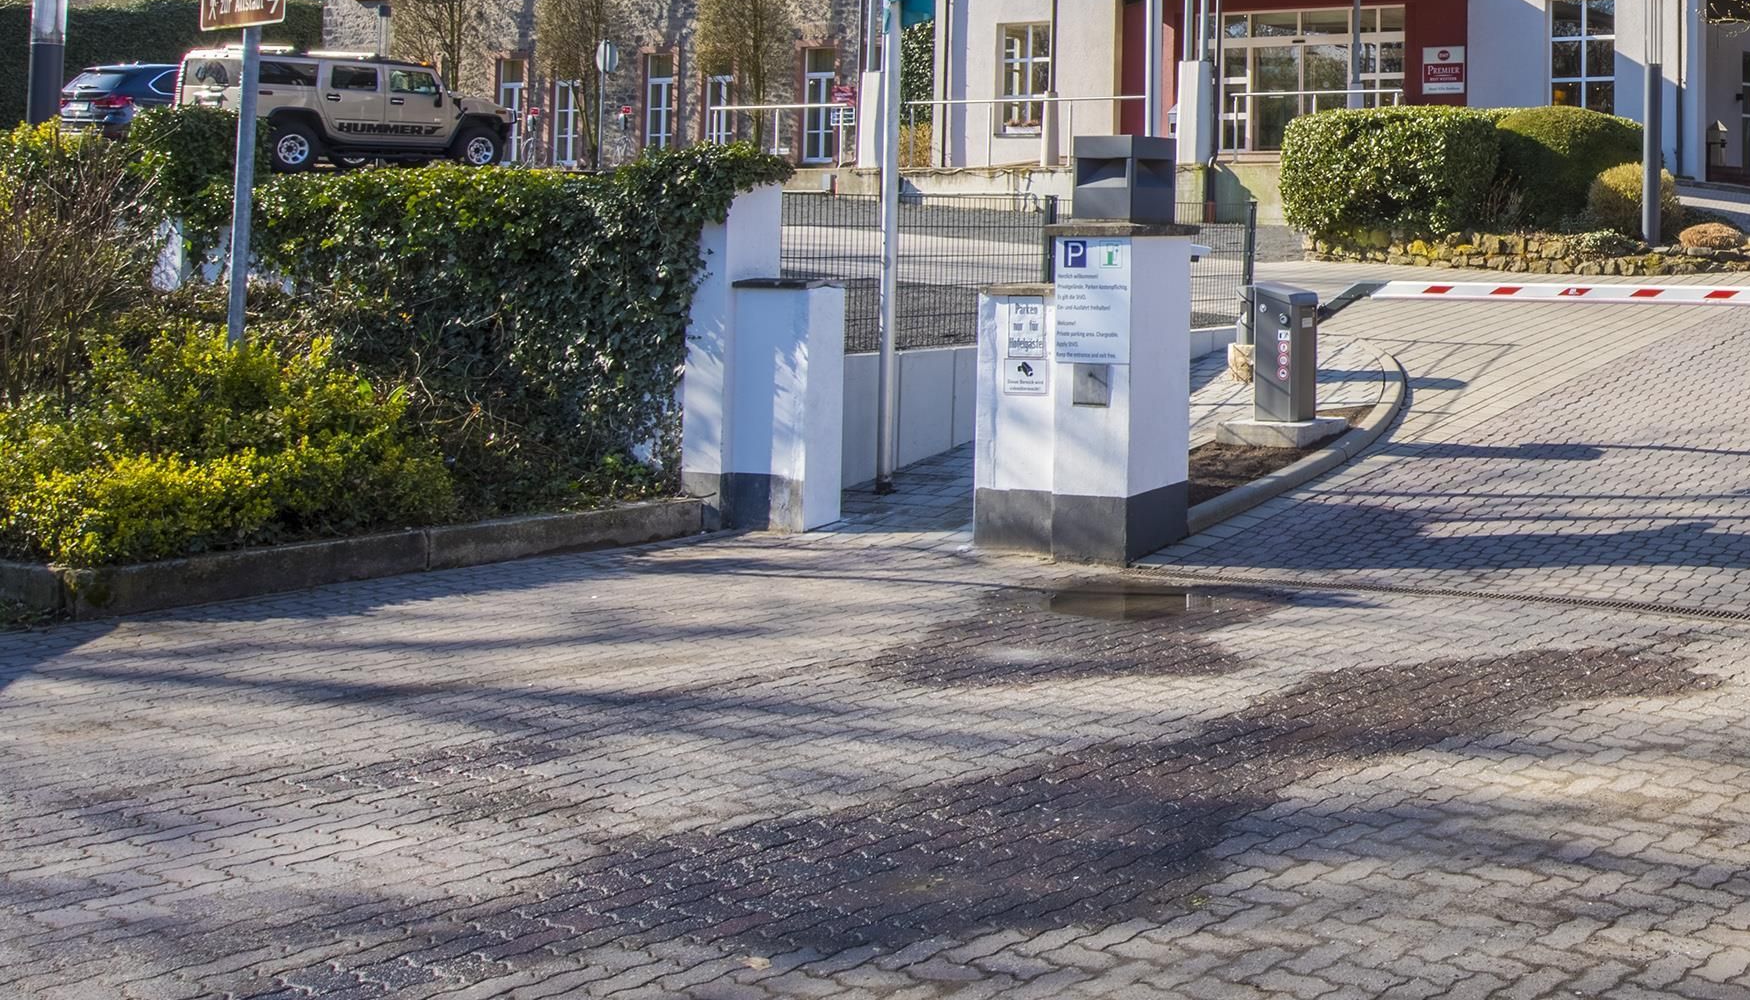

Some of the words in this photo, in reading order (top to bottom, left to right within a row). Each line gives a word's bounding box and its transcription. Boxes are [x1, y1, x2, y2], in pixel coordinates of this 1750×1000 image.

[338, 122, 424, 135] HUMMER
[1067, 242, 1084, 267] P
[1015, 302, 1038, 315] Parken
